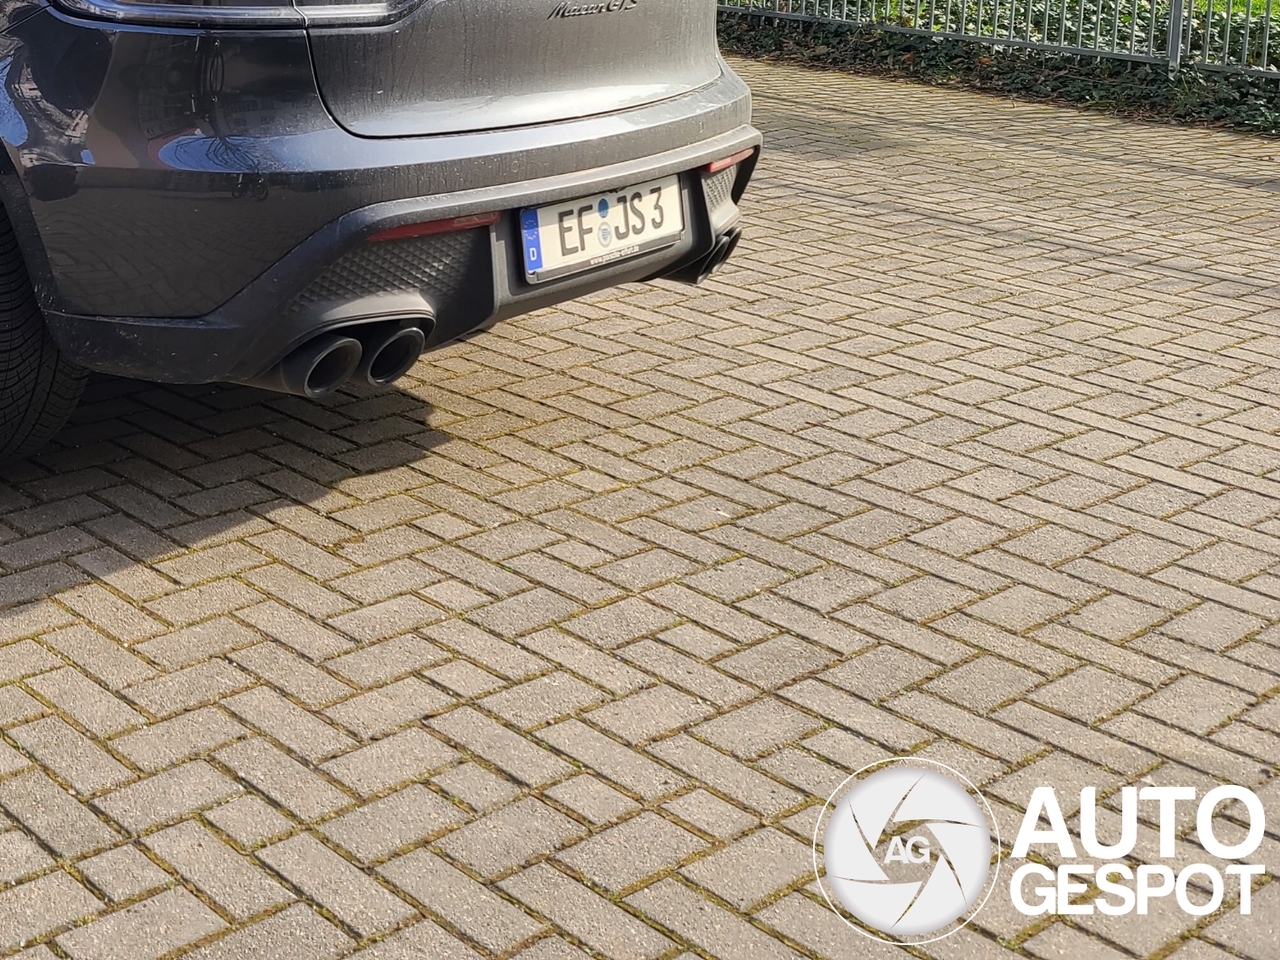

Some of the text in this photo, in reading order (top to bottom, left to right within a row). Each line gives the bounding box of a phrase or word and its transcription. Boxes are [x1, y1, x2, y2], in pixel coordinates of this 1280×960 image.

[547, 0, 605, 21] Macan
[558, 186, 665, 257] EF JS 3
[529, 247, 537, 261] D
